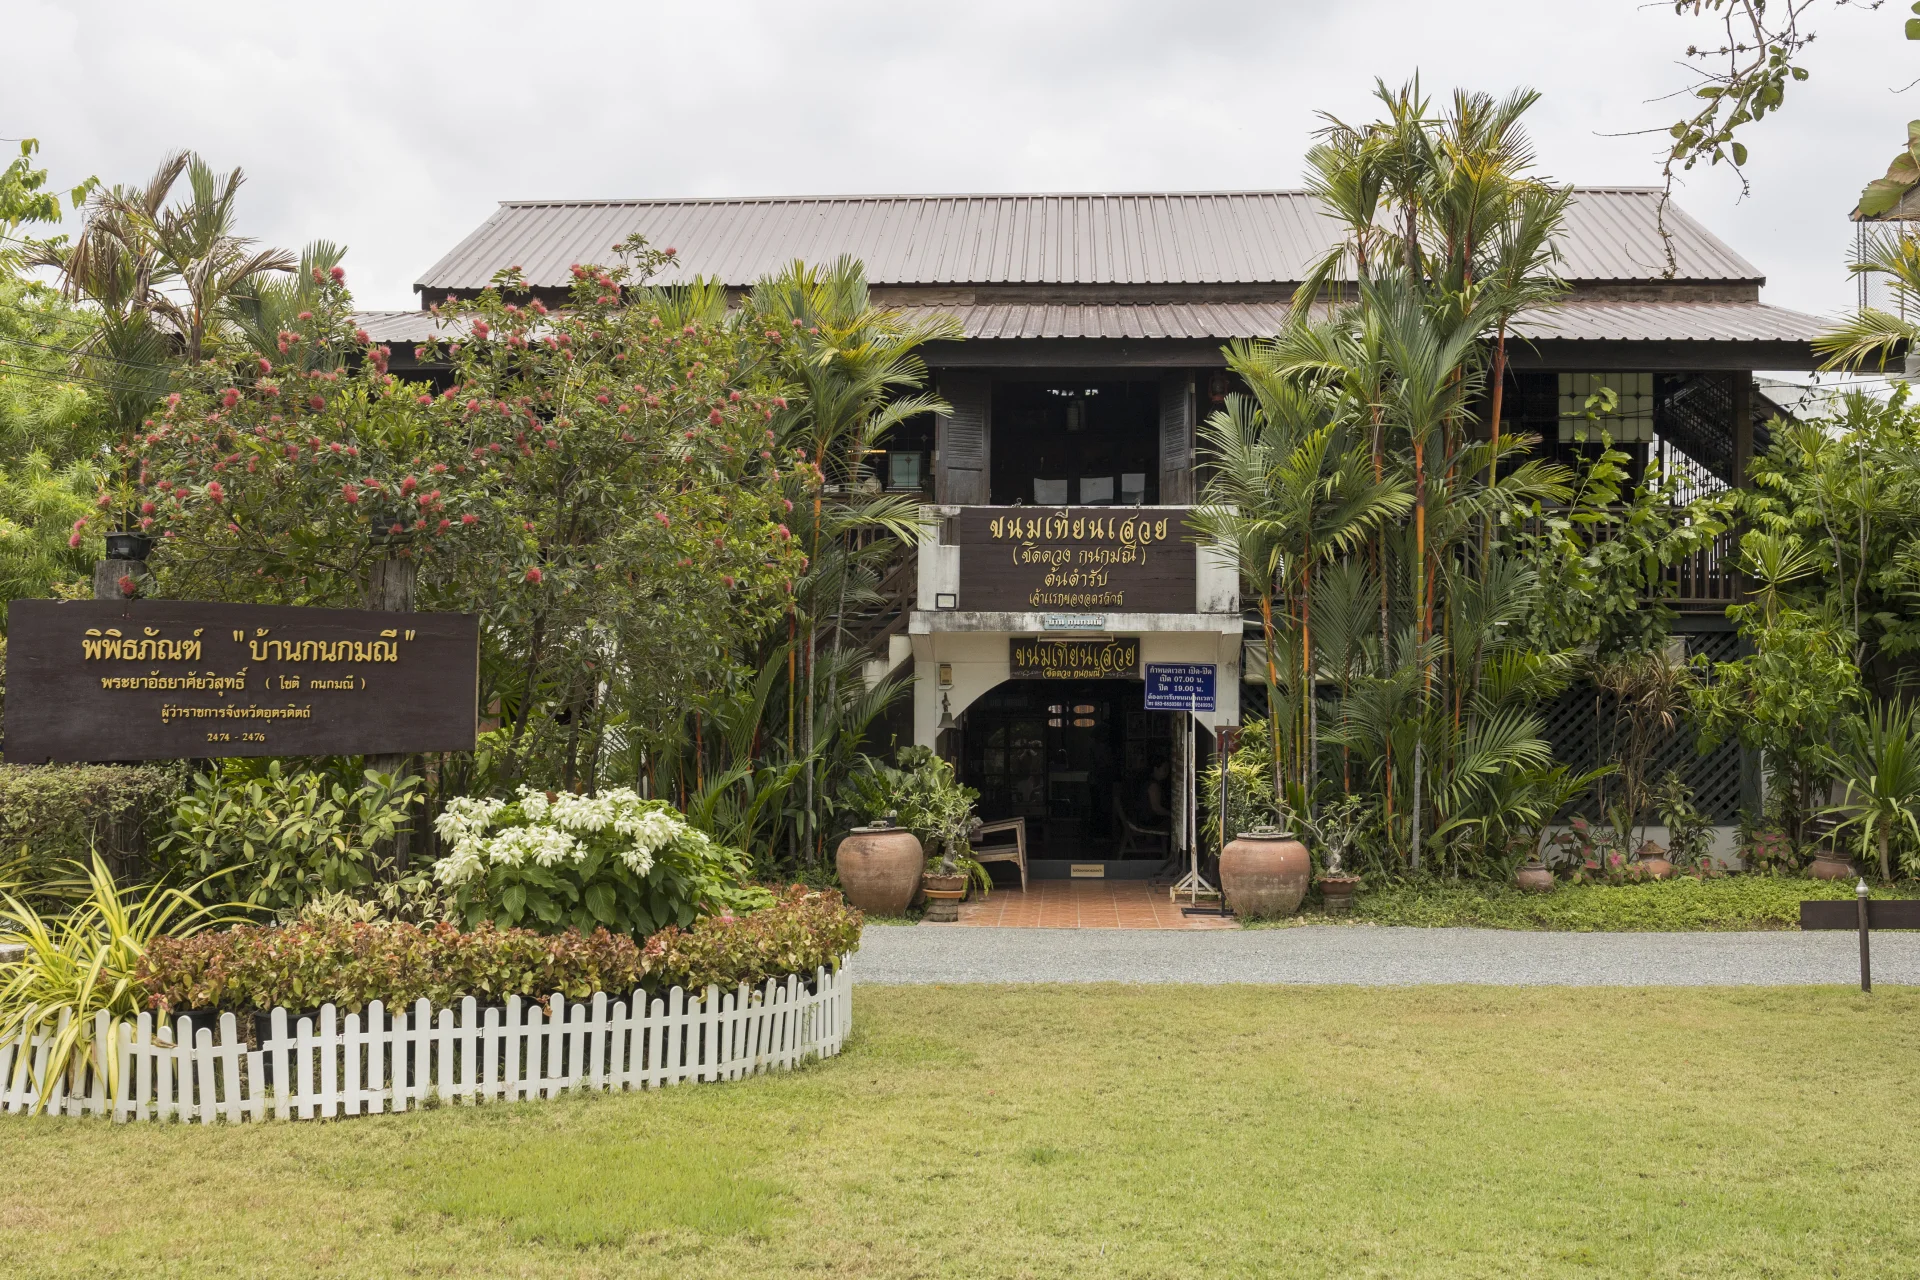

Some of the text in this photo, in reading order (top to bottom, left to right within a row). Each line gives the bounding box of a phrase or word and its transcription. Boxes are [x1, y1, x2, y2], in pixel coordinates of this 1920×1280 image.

[989, 509, 1169, 545] ขนมเทียนเสวย
[1044, 566, 1109, 588] ต้นตำรับ
[81, 627, 416, 663] พิพิธภัณฑ์ "บ้านกนกมณี"
[1016, 641, 1136, 672] ขนมเทียนเสวย
[101, 667, 248, 697] พระยาอัธยาศัยวิสุทธิ์
[1150, 666, 1186, 674] กำหนดเวลา
[161, 703, 311, 724] ผู้ว่าราชการจังหวัดอุตรดิตถ์
[207, 732, 231, 742] 2474
[242, 732, 265, 742] 2476
